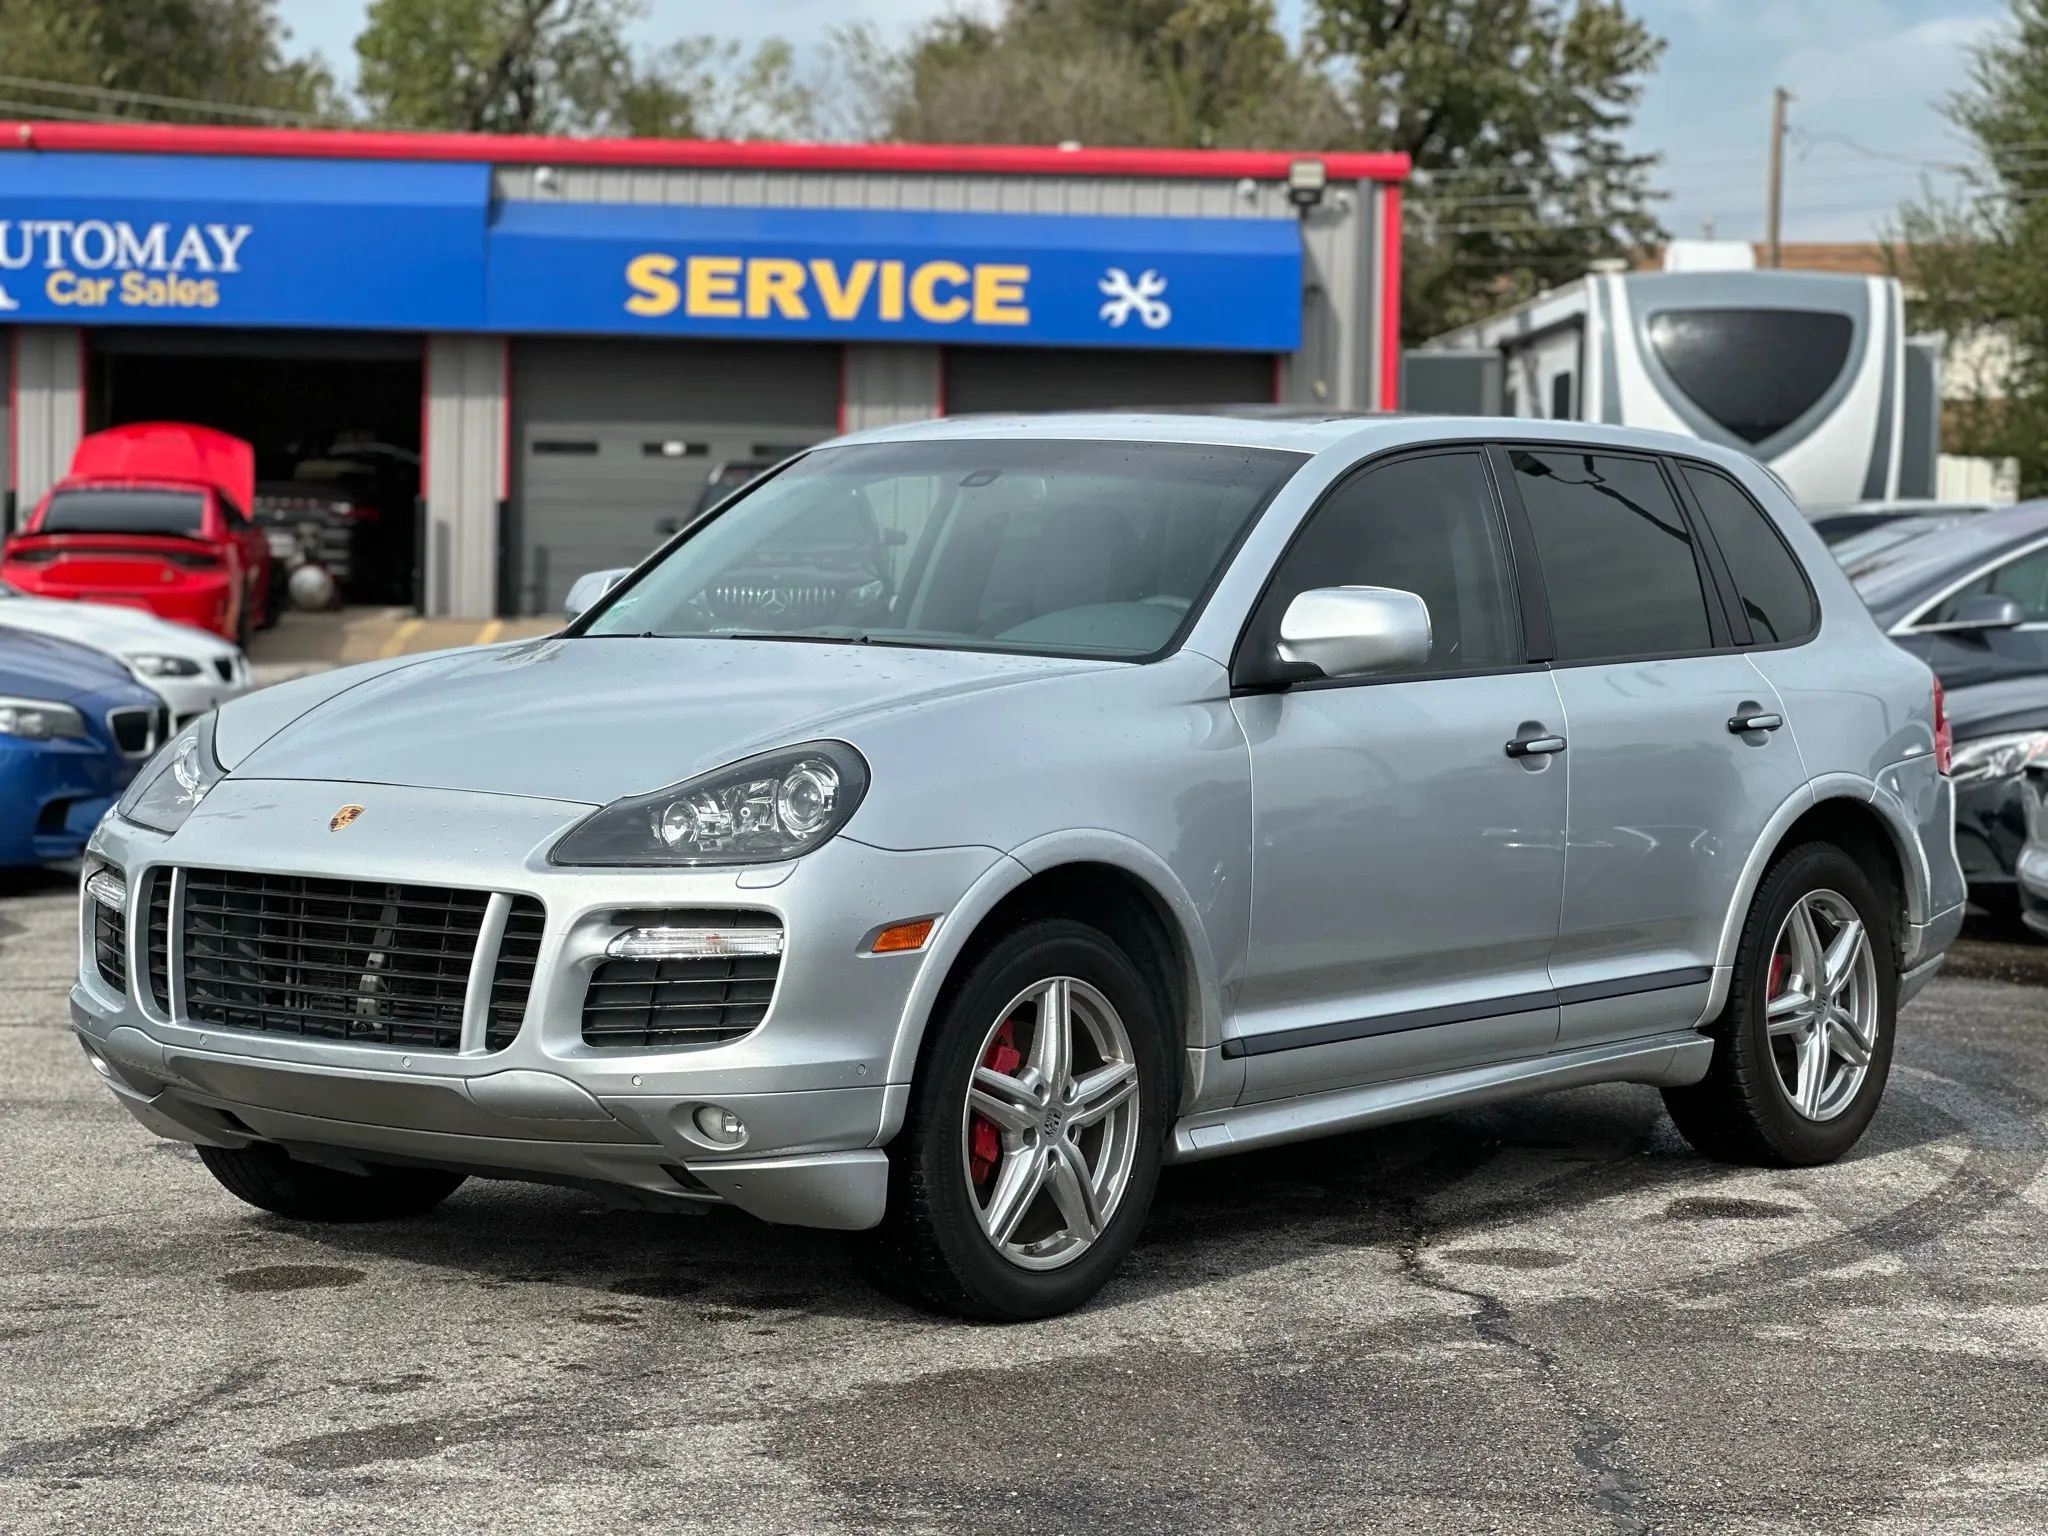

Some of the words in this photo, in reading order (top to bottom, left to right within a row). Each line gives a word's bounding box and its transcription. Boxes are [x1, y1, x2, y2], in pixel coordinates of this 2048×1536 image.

[0, 220, 252, 272] UTOMAY
[46, 270, 114, 305] Car
[120, 271, 219, 307] Sales
[625, 253, 1030, 325] SERVICE
